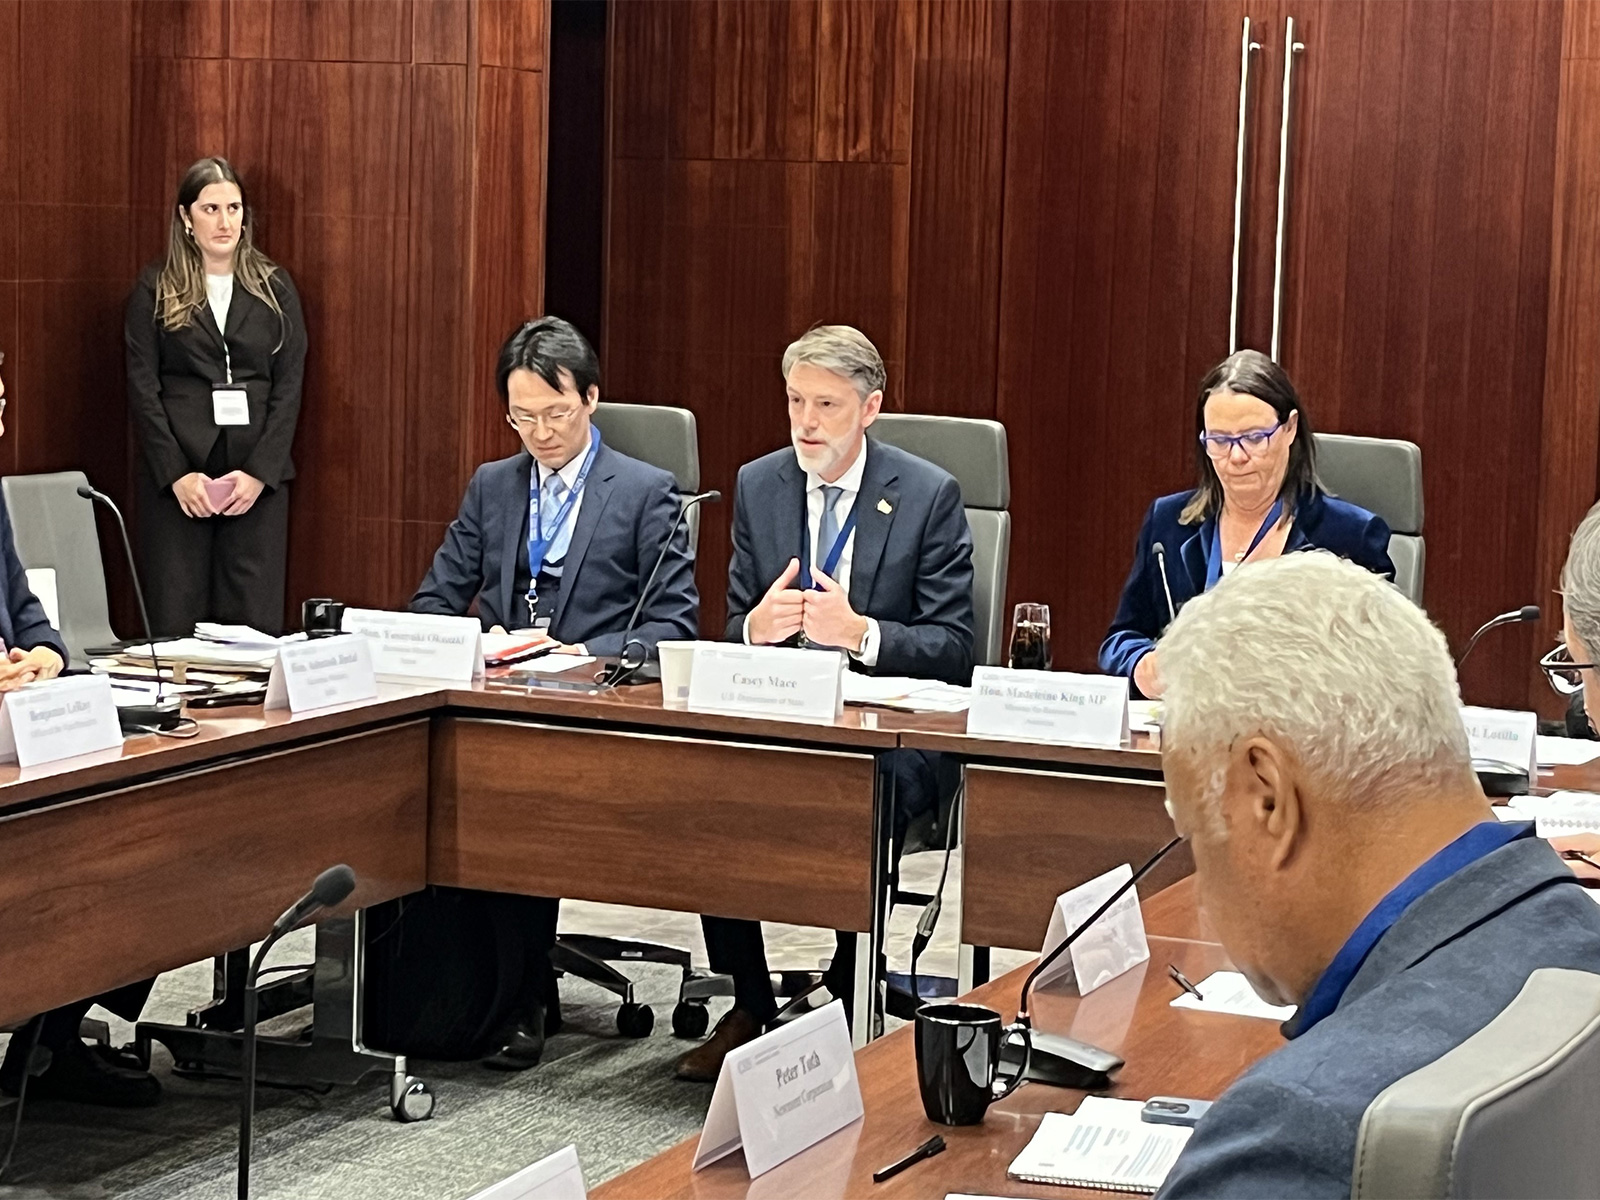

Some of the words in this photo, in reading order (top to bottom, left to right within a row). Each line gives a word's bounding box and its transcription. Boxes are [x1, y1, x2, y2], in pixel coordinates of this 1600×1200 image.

[732, 672, 764, 688] Casey
[768, 675, 797, 688] Mace
[979, 685, 1003, 696] Hon.
[1006, 687, 1058, 701] Madeleine
[1060, 692, 1084, 705] King
[1088, 693, 1107, 705] MP
[776, 1064, 799, 1089] Peter
